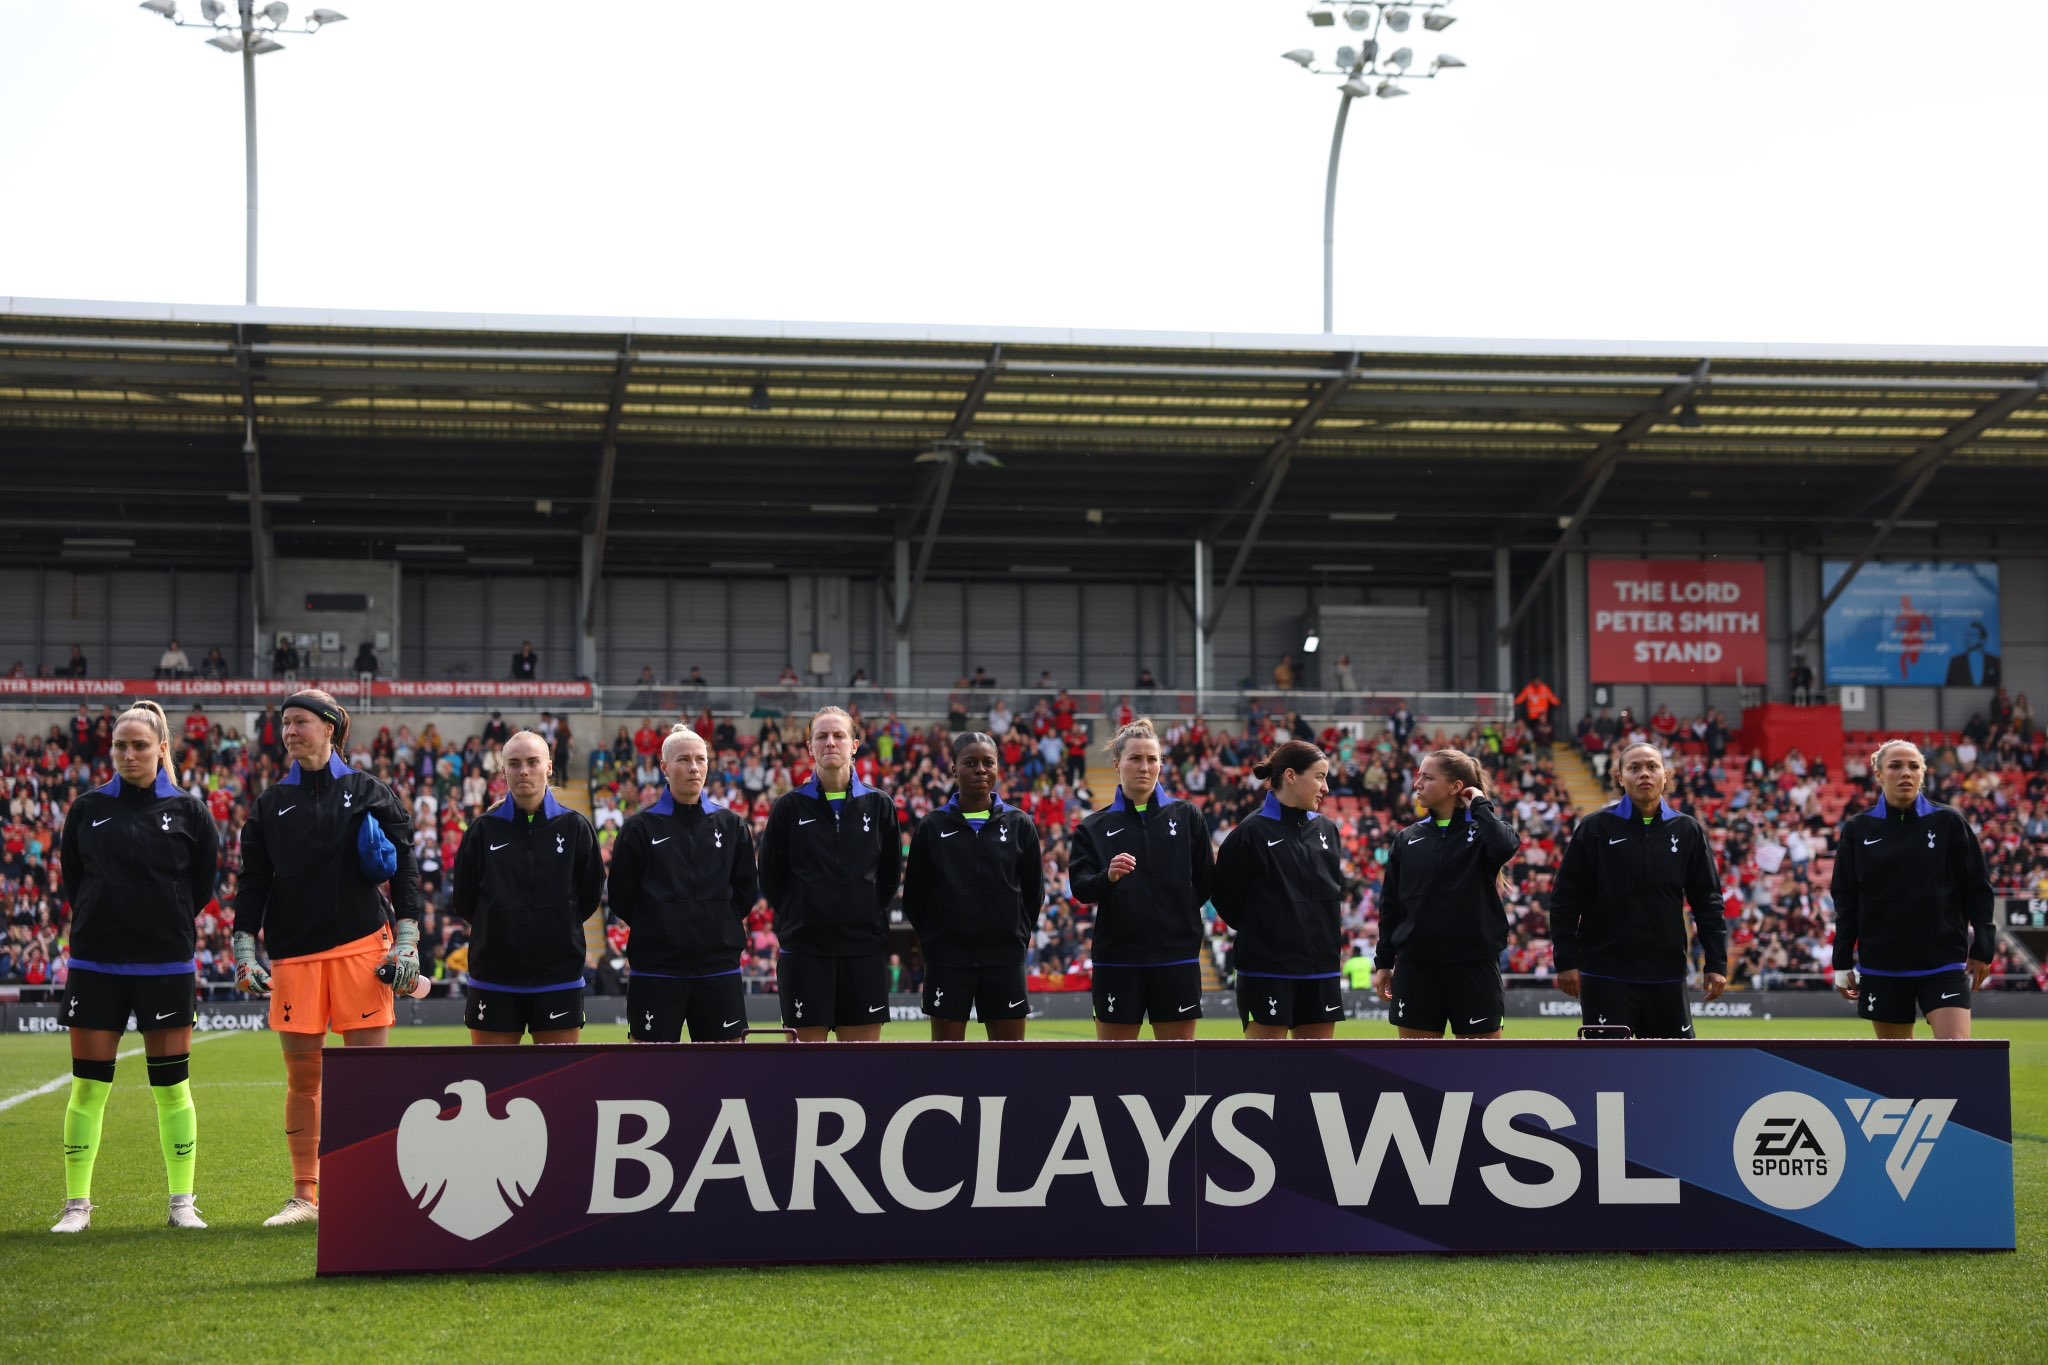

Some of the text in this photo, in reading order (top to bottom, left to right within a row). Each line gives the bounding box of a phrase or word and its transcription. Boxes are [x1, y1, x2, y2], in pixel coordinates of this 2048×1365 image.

[1613, 581, 1740, 603] THE LORD
[1596, 611, 1760, 634] PETER SMITH
[1634, 641, 1722, 663] STAND
[0, 680, 125, 693] TER SMITH STAND
[156, 680, 182, 694] THE
[185, 680, 223, 694] LORD
[224, 680, 265, 694] PETER
[389, 682, 586, 695] THE LORD PETER SMITH STAND
[1753, 1118, 1826, 1156] EA
[586, 1090, 1681, 1214] BARCLAYS WSL
[1752, 1159, 1828, 1176] SPORTS
